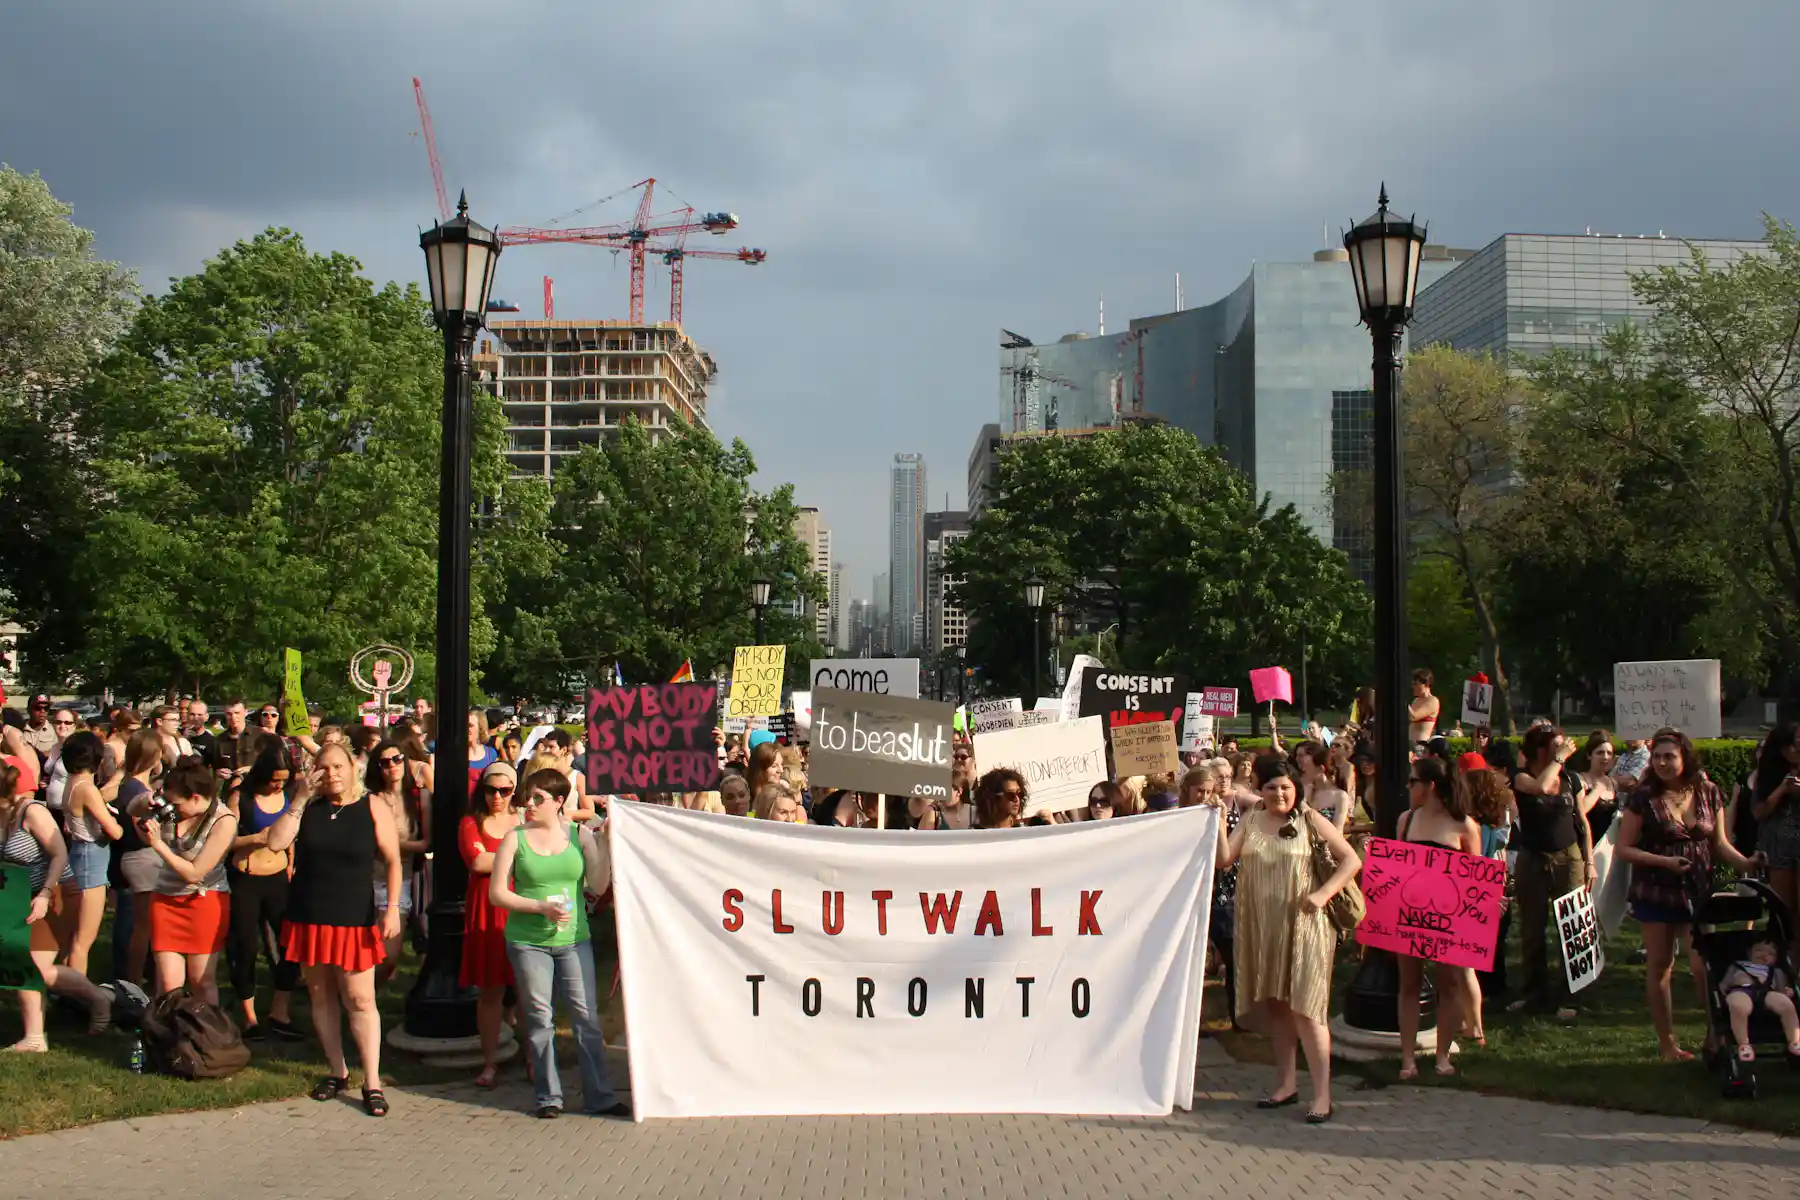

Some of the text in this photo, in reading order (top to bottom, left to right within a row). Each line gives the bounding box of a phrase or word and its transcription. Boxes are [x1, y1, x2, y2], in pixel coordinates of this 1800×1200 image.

[736, 646, 785, 667] MY BODY
[734, 668, 784, 683] IS NOT
[1096, 674, 1174, 694] CONSENT
[742, 684, 775, 699] YOUR
[1206, 691, 1219, 701] REAL
[587, 686, 638, 720] MY
[640, 684, 717, 718] BODY
[730, 699, 778, 715] OBJECT
[972, 701, 1013, 715] CONSENT
[1125, 695, 1140, 711] IS
[1620, 700, 1671, 716] NEVER
[588, 716, 699, 751] IS NOT
[816, 708, 846, 750] to
[911, 784, 946, 796] .com
[1370, 840, 1416, 865] Even
[1443, 852, 1454, 874] I
[722, 887, 1103, 937] SLUTWALK
[1397, 907, 1452, 931] NAKED
[745, 974, 1091, 1018] TORONTO
